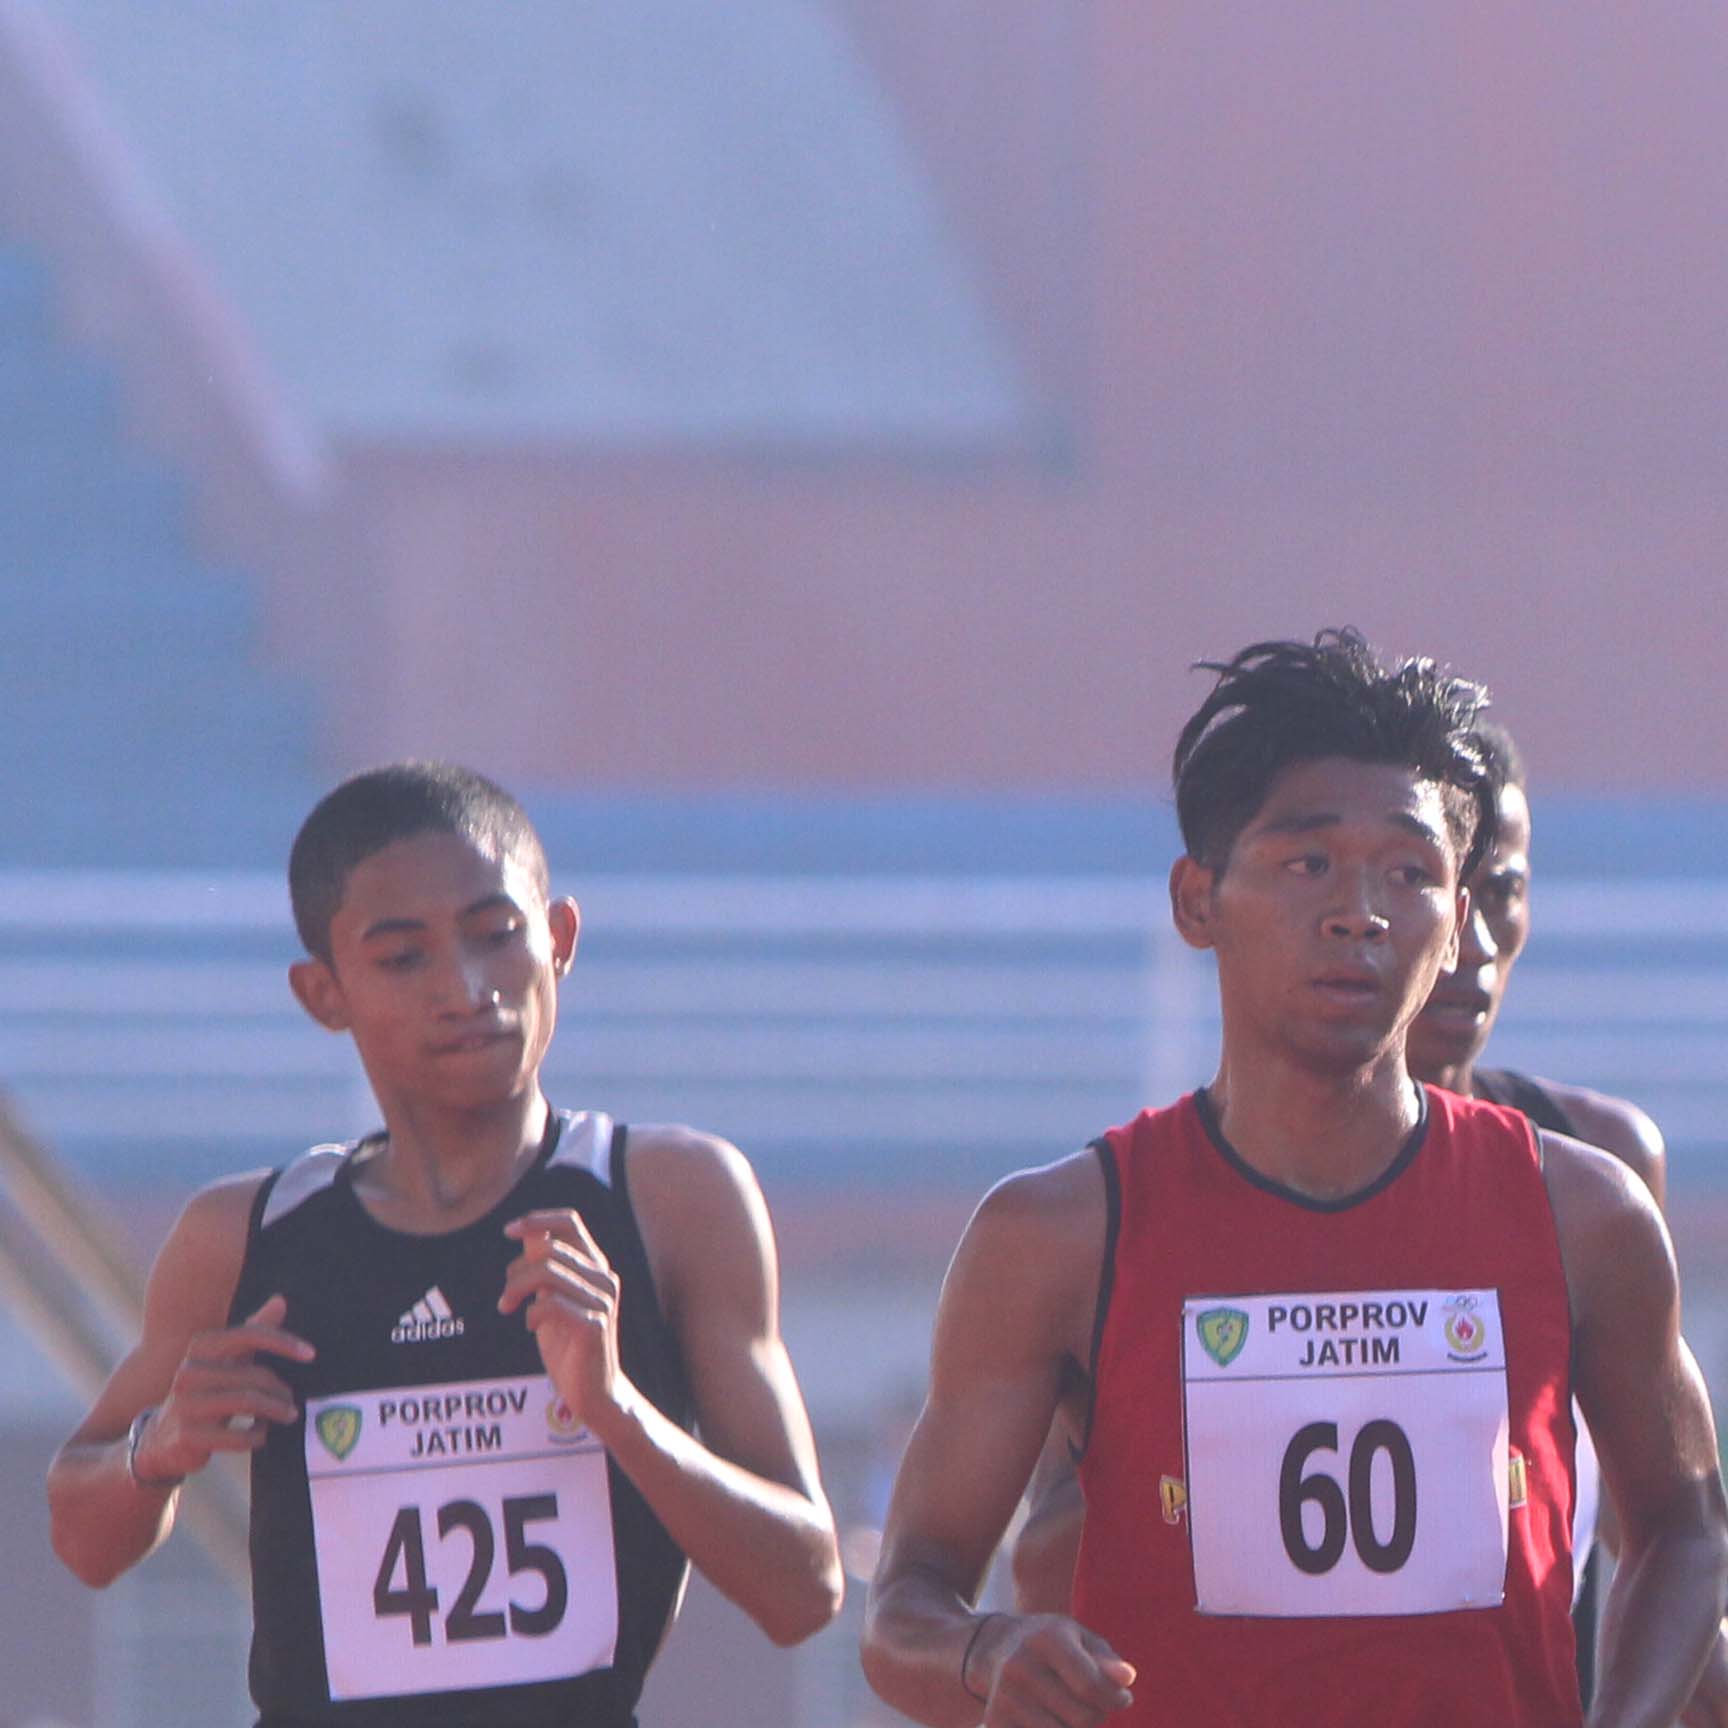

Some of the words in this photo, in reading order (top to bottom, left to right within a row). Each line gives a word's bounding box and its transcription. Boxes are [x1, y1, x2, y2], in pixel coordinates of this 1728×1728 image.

[390, 1316, 465, 1344] adidas
[1267, 1301, 1429, 1333] PORPROV
[1299, 1337, 1401, 1367] JATIM
[378, 1387, 528, 1427] PORPROV
[410, 1423, 503, 1458] JATIM
[1278, 1418, 1418, 1577] 60
[373, 1492, 569, 1649] 425
